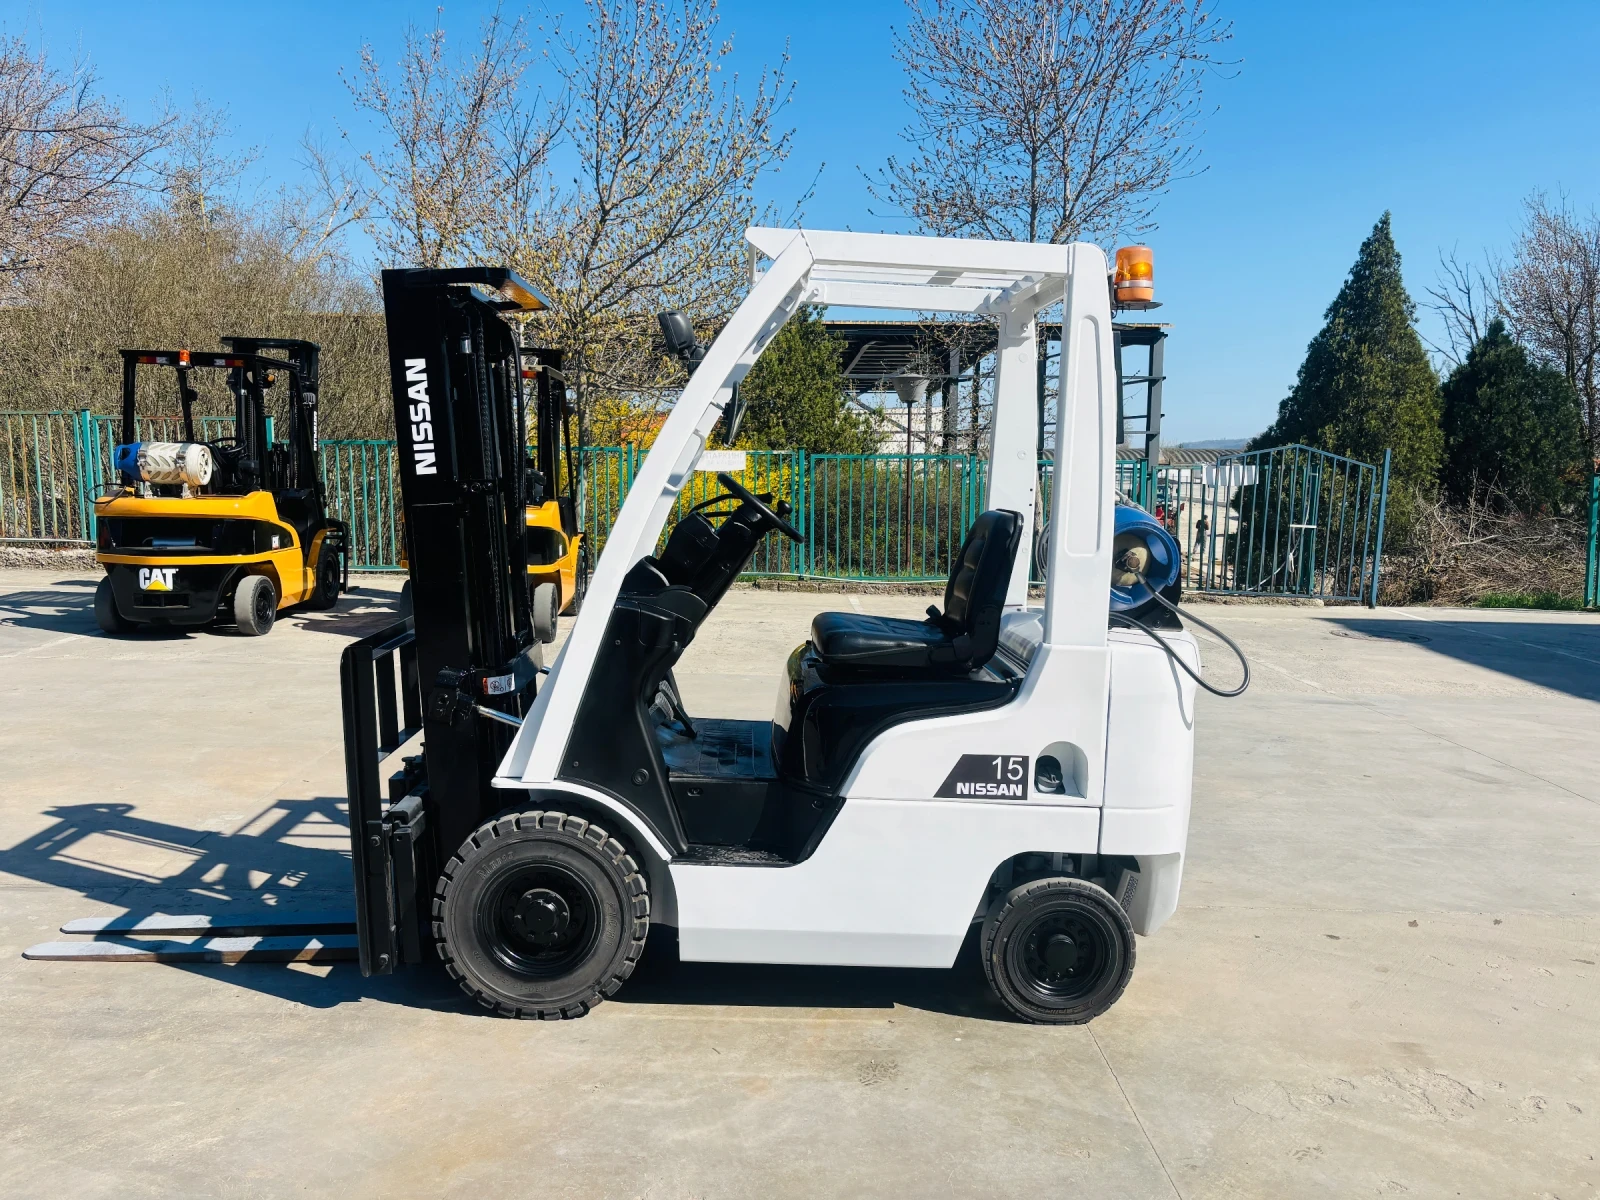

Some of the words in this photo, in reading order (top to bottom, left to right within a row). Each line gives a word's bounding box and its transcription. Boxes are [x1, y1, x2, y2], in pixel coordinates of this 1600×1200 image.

[405, 358, 437, 475] NISSAN
[139, 567, 177, 591] CAT
[992, 756, 1024, 780] 15
[956, 782, 1022, 796] NISSAN
